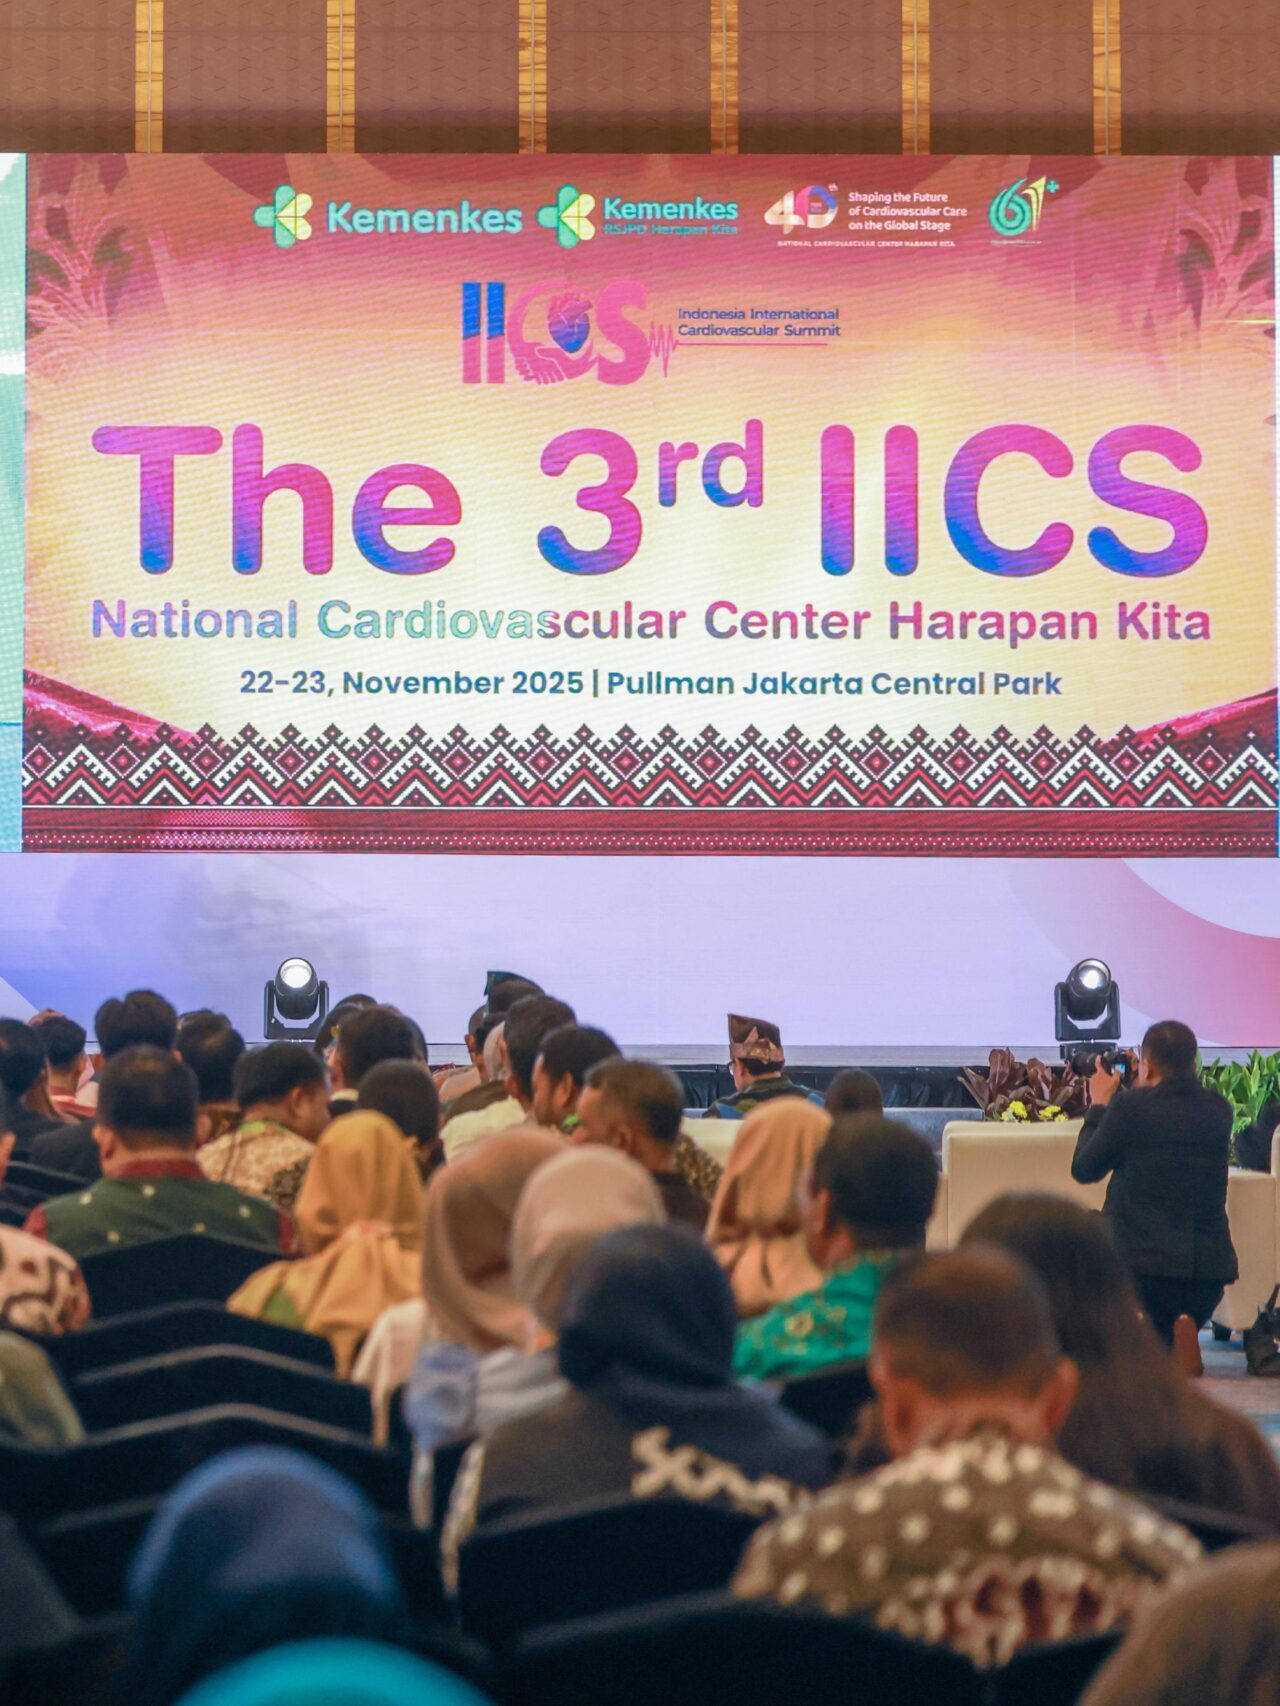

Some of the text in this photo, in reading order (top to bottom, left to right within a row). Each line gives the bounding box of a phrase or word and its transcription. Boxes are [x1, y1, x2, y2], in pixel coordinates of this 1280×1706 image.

[848, 191, 949, 204] Shaping the Future
[327, 200, 523, 234] Kemenkes
[603, 196, 739, 220] Kemenkes
[848, 205, 968, 217] of Cardiovascular Care
[848, 219, 952, 233] on the Global Stage
[678, 308, 839, 320] Indonesia International
[678, 324, 841, 336] Cardiovascular Summit
[91, 418, 1209, 578] The 3rd IICS
[91, 600, 1211, 650] National Cardiovascular Center Harapan Kita
[343, 670, 505, 695] November
[512, 671, 585, 695] 2025
[607, 671, 735, 695] Pullman
[742, 671, 864, 696] Jakarta
[871, 671, 986, 696] Central
[994, 672, 1063, 696] Park
